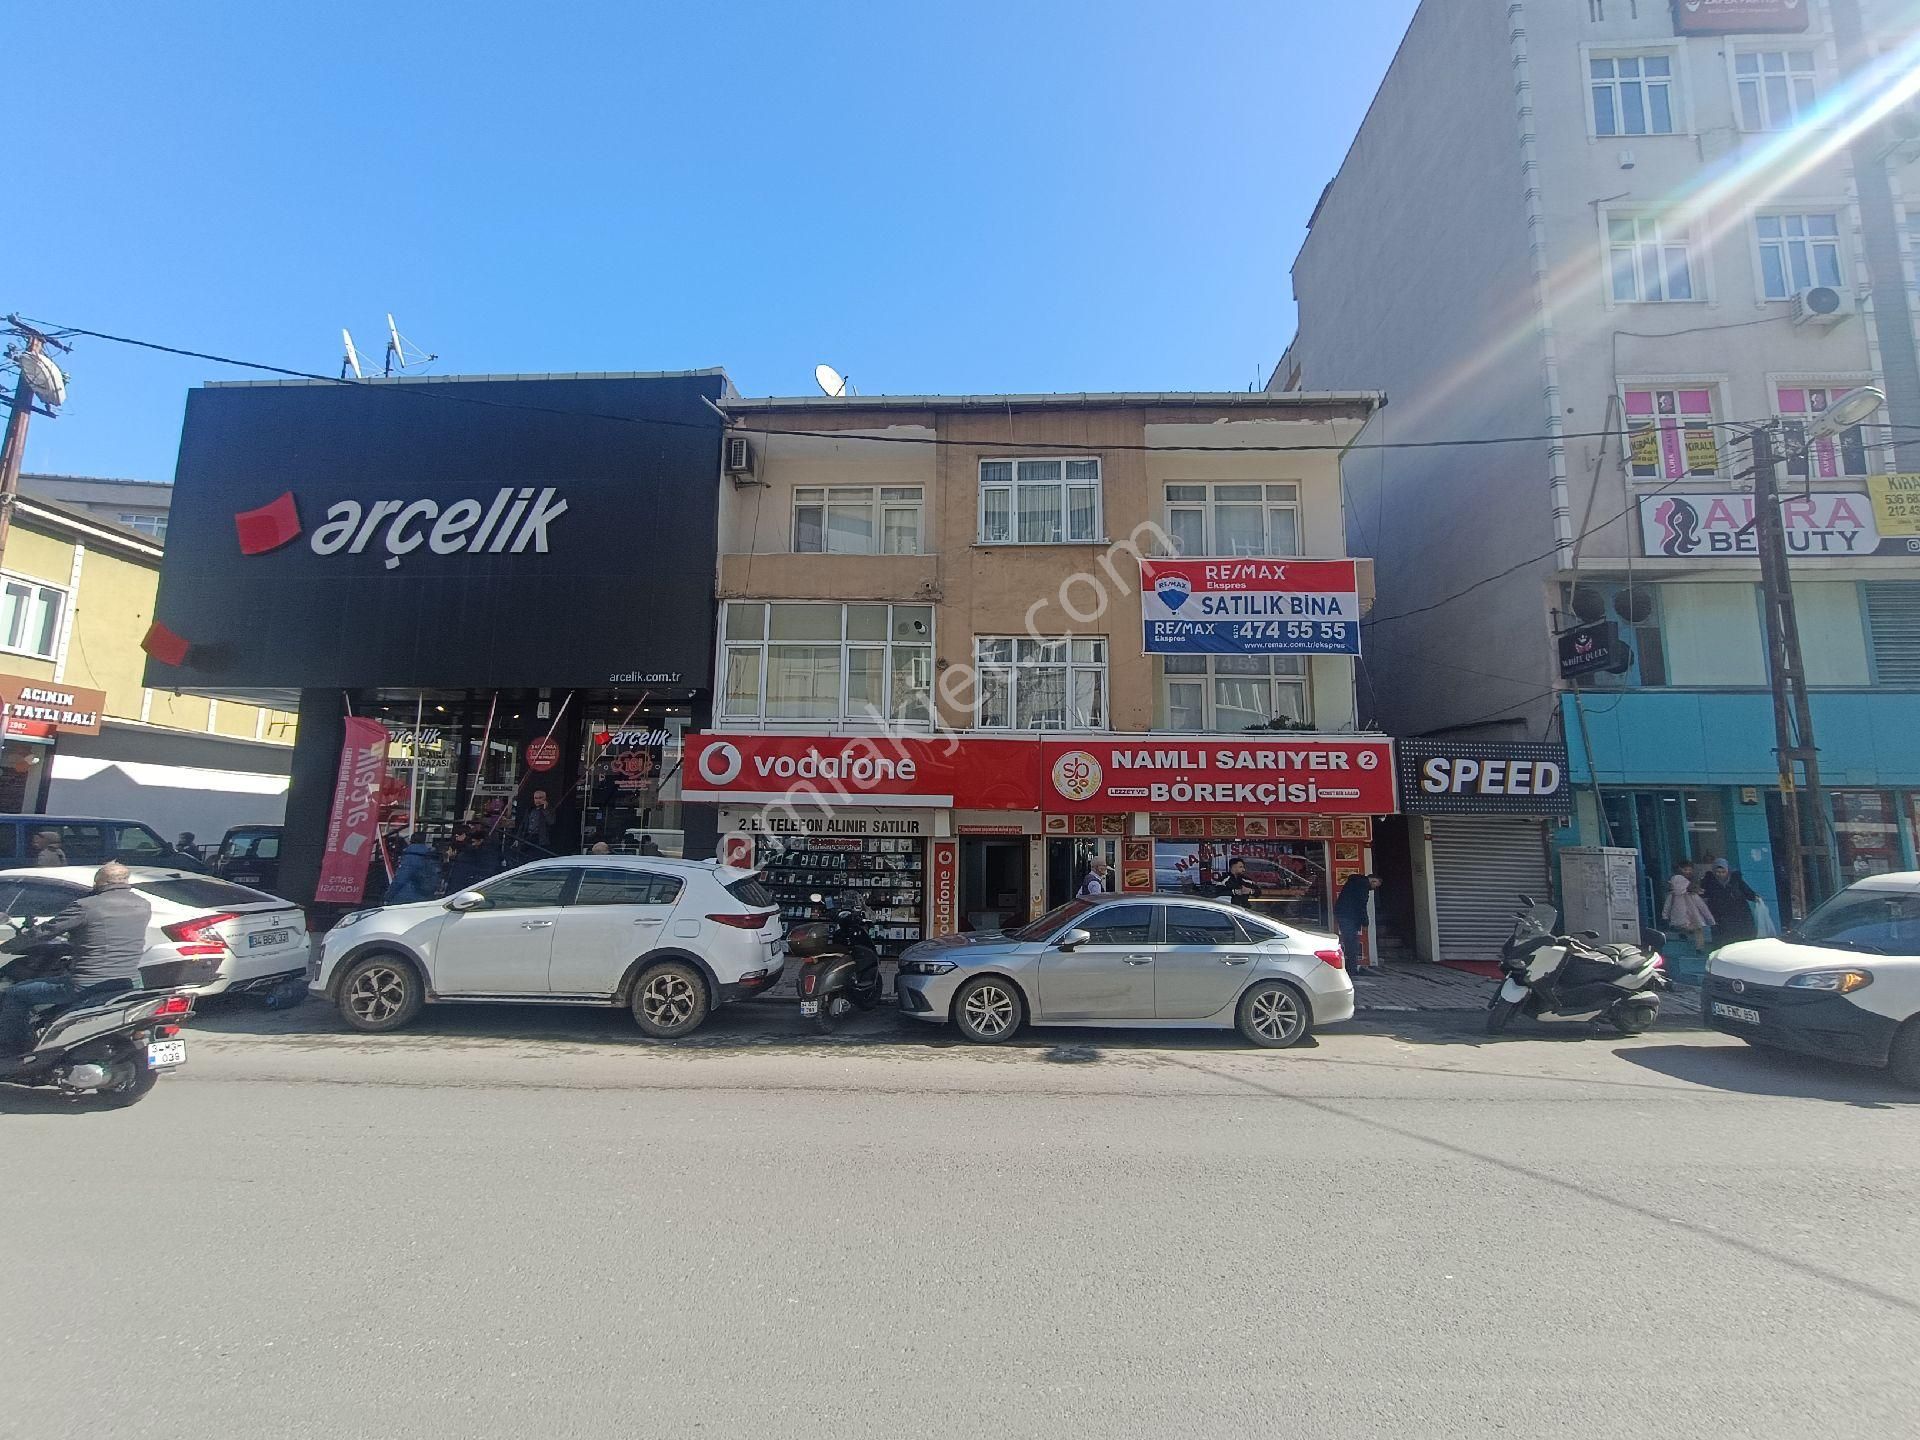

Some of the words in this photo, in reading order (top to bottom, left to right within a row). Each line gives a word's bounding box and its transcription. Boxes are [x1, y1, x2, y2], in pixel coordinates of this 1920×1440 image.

[310, 487, 569, 570] arçelik
[1708, 531, 1859, 551] BEUTY
[1205, 565, 1285, 580] RE/MAX
[1158, 580, 1187, 589] RE/MAX
[1207, 581, 1247, 590] Ekspres
[1202, 595, 1284, 616] SATILIK
[1290, 594, 1343, 616] BİNA
[1155, 622, 1216, 635] RE/MAX
[1239, 621, 1280, 639] 474
[1287, 621, 1313, 639] 55
[1320, 622, 1346, 639] 55
[1155, 635, 1186, 643] Ekspres
[1244, 641, 1347, 650] www.remax.com.tr/ekspres
[609, 671, 681, 682] arcelik.com.tr
[14, 704, 60, 721] TATLI
[753, 749, 917, 780] vodafone
[1111, 750, 1207, 769] NAMLI
[1215, 750, 1350, 770] SARIYER
[1421, 757, 1560, 795] SPEED
[1150, 776, 1317, 805] BÖREKÇİSİ
[769, 818, 823, 832] TELEFON
[826, 819, 867, 832] ALINIR
[872, 820, 920, 834] SATILIR
[937, 870, 951, 937] odafone
